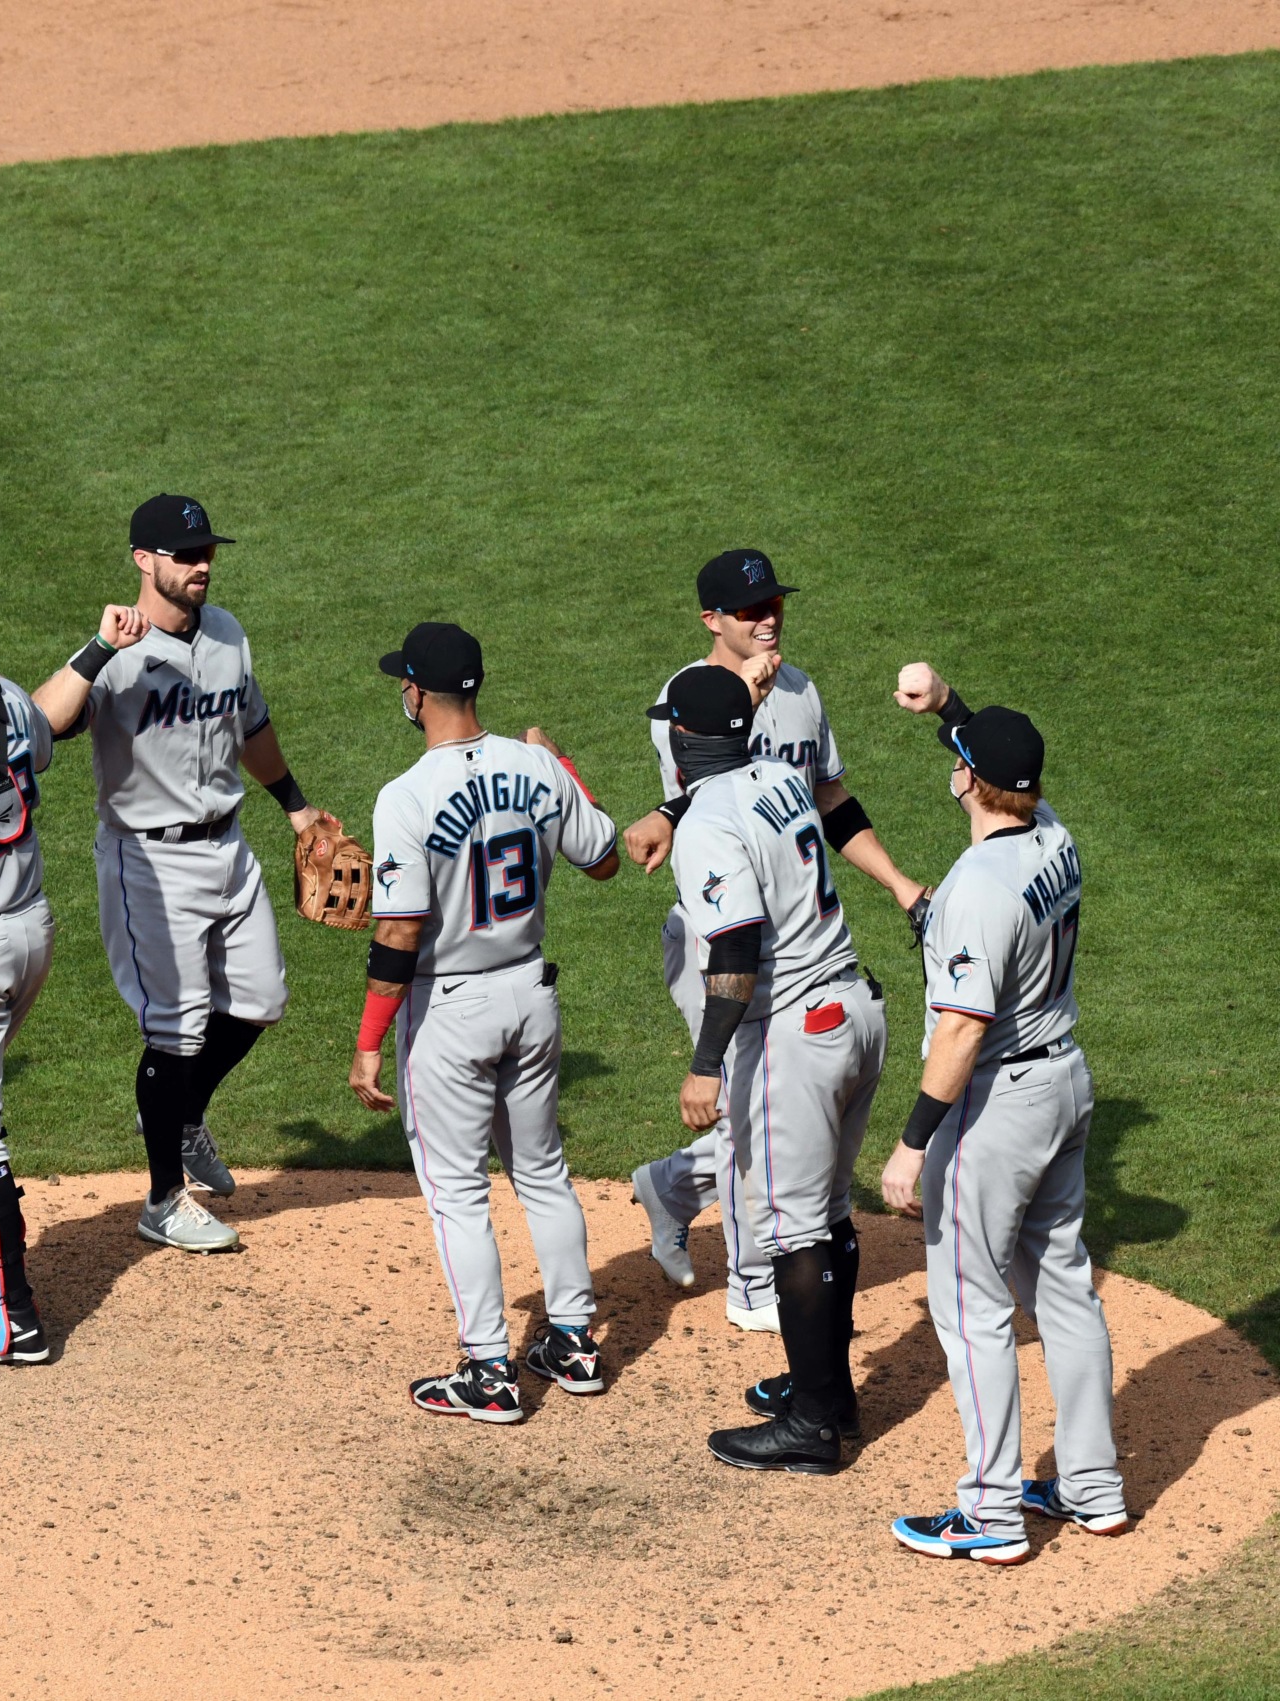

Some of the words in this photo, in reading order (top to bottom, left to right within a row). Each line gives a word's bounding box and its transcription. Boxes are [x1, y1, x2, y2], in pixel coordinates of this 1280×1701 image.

[135, 674, 248, 737] Miami
[424, 772, 562, 860] RODRIGUEZ
[469, 826, 539, 932] 13
[795, 823, 840, 920] 2
[1022, 843, 1082, 927] WALLAC
[1035, 898, 1080, 1010] 17
